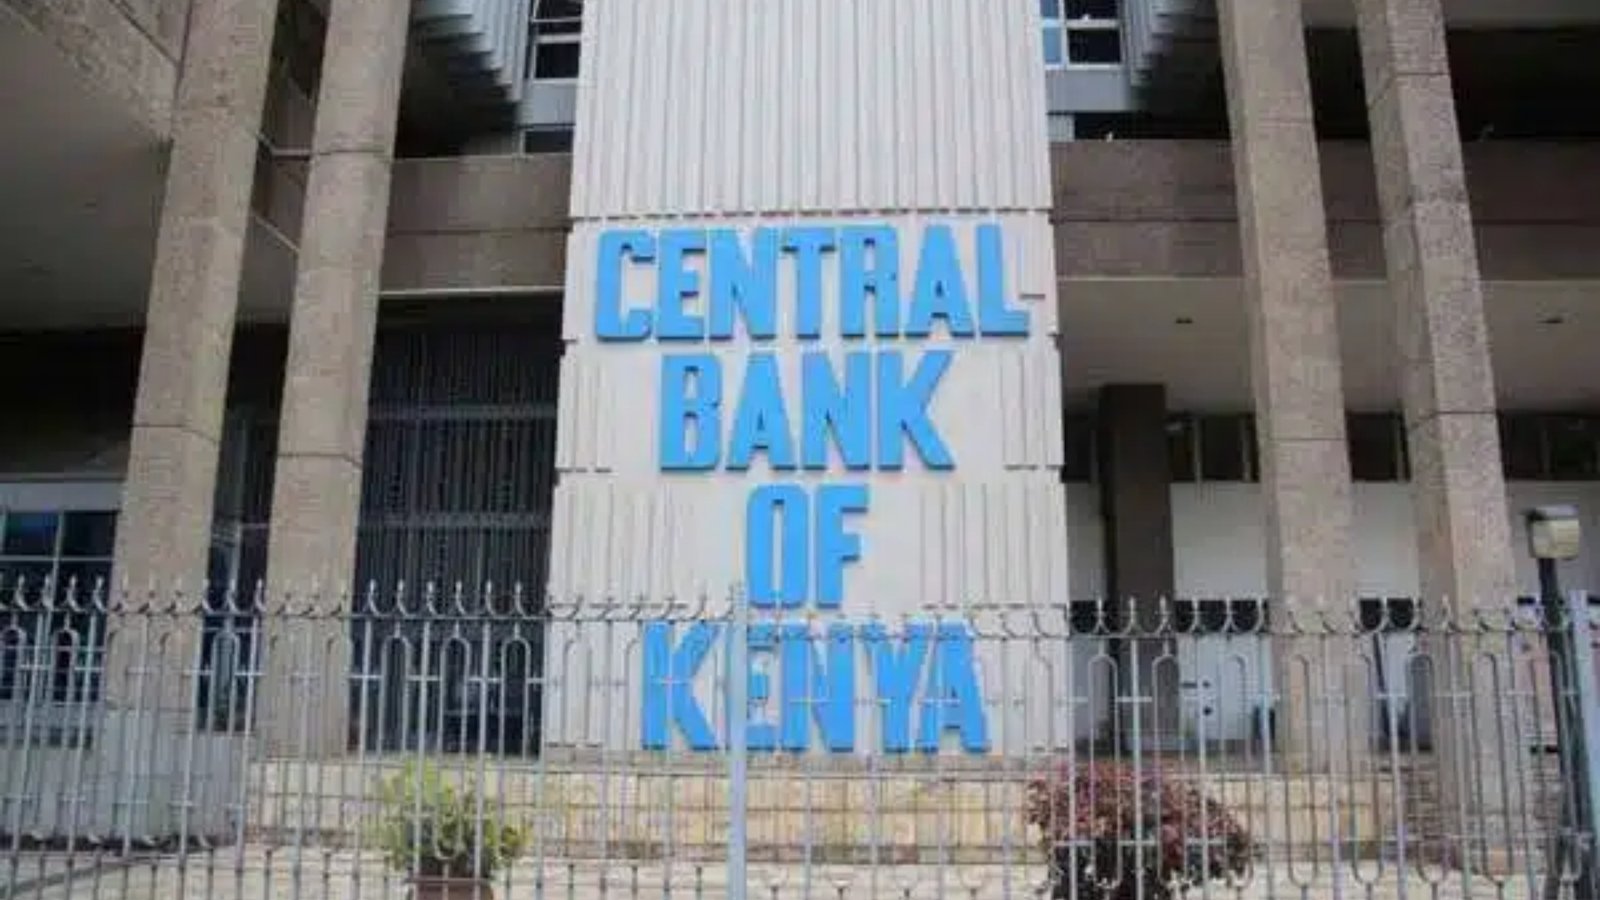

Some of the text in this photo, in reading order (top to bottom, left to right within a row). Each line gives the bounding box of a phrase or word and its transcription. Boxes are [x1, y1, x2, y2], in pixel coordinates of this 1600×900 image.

[594, 224, 1030, 341] CENTRAL
[660, 350, 955, 472] BANK
[746, 483, 870, 609] OF
[642, 620, 990, 754] KENYA
